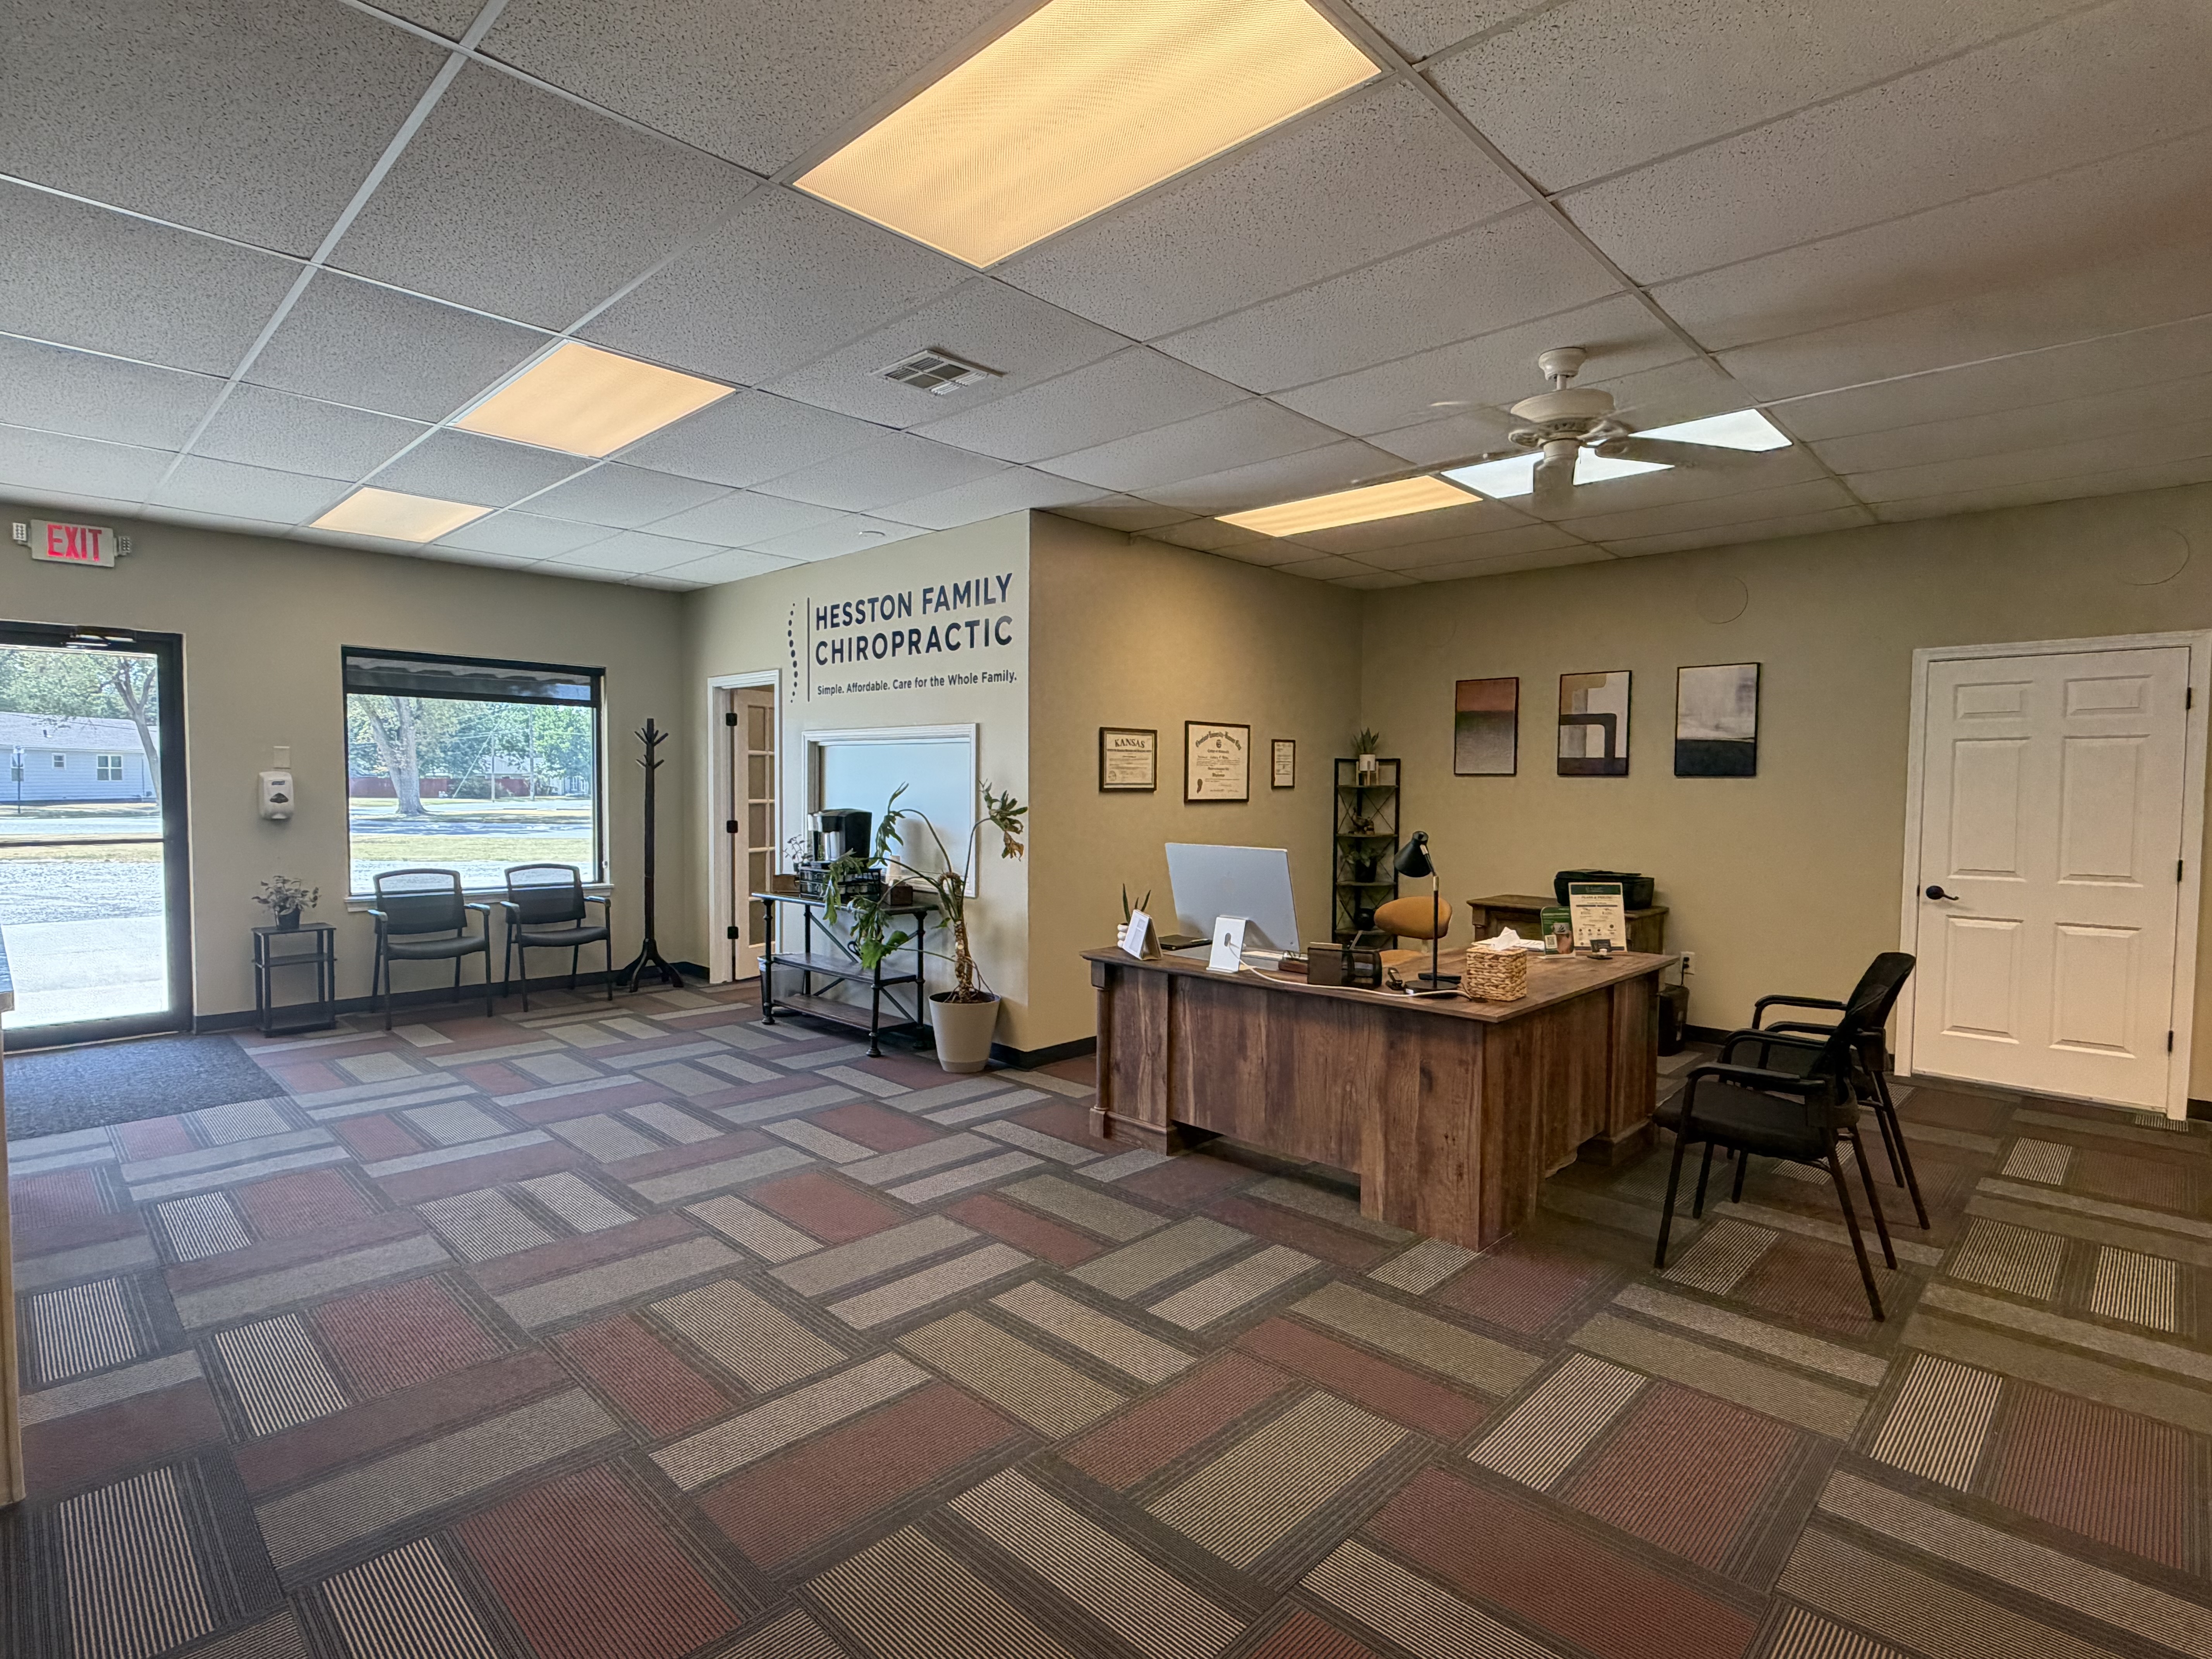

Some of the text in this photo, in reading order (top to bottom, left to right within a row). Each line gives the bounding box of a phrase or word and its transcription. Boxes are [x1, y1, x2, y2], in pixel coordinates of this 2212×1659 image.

[47, 524, 102, 561] EXIT
[816, 572, 1013, 631] HESSTON FAMILY
[815, 616, 1013, 666] CHIROPRACTIC
[817, 669, 1017, 696] Simple. Affordable. Care for the Whole Family.
[1115, 738, 1145, 748] KANSAS
